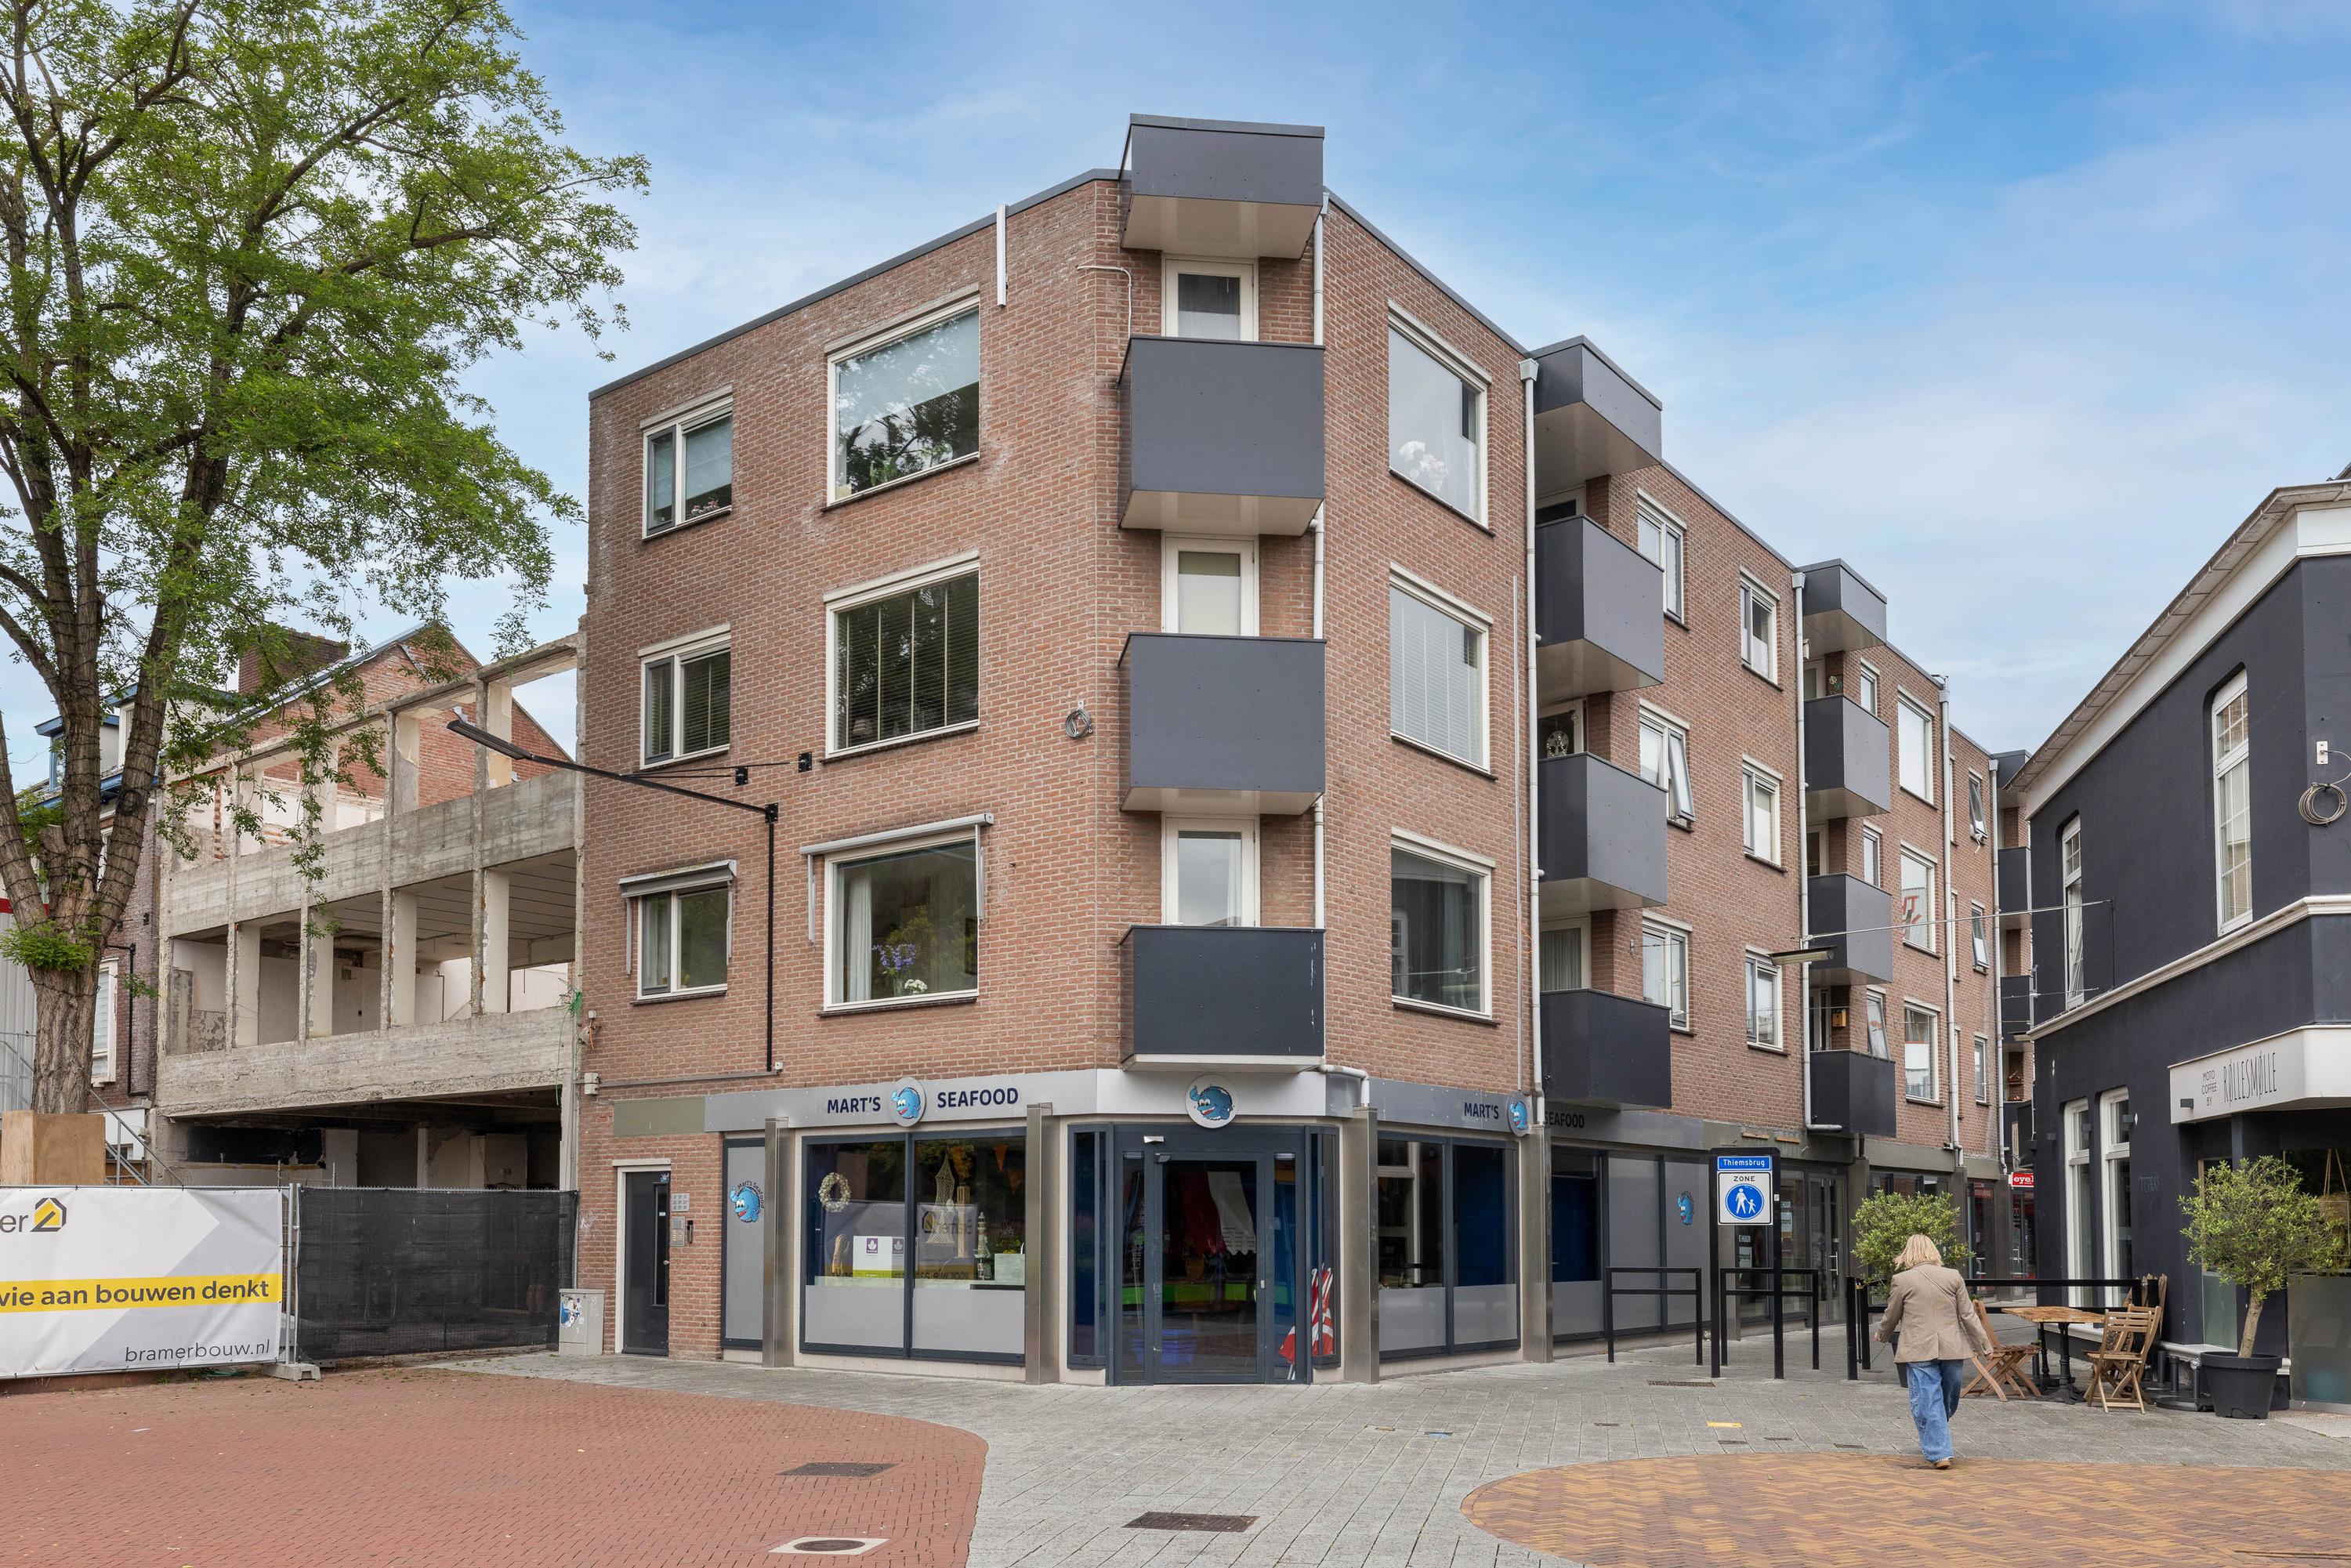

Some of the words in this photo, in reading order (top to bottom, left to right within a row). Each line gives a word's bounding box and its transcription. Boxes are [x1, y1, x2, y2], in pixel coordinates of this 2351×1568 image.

[2202, 1070, 2215, 1081] MOTO
[2201, 1082, 2217, 1094] COFFEE
[827, 1096, 881, 1114] MART'S
[937, 1088, 1019, 1109] SEAFOOD
[2206, 1097, 2212, 1106] BY
[1464, 1102, 1499, 1120] MART'S
[1723, 1159, 1765, 1168] Thiemsbrug
[753, 1182, 766, 1209] Seafood
[41, 1290, 88, 1305] aan
[96, 1284, 195, 1303] bouwen
[201, 1280, 269, 1299] denkt
[125, 1339, 270, 1362] bramerbouw.nl
